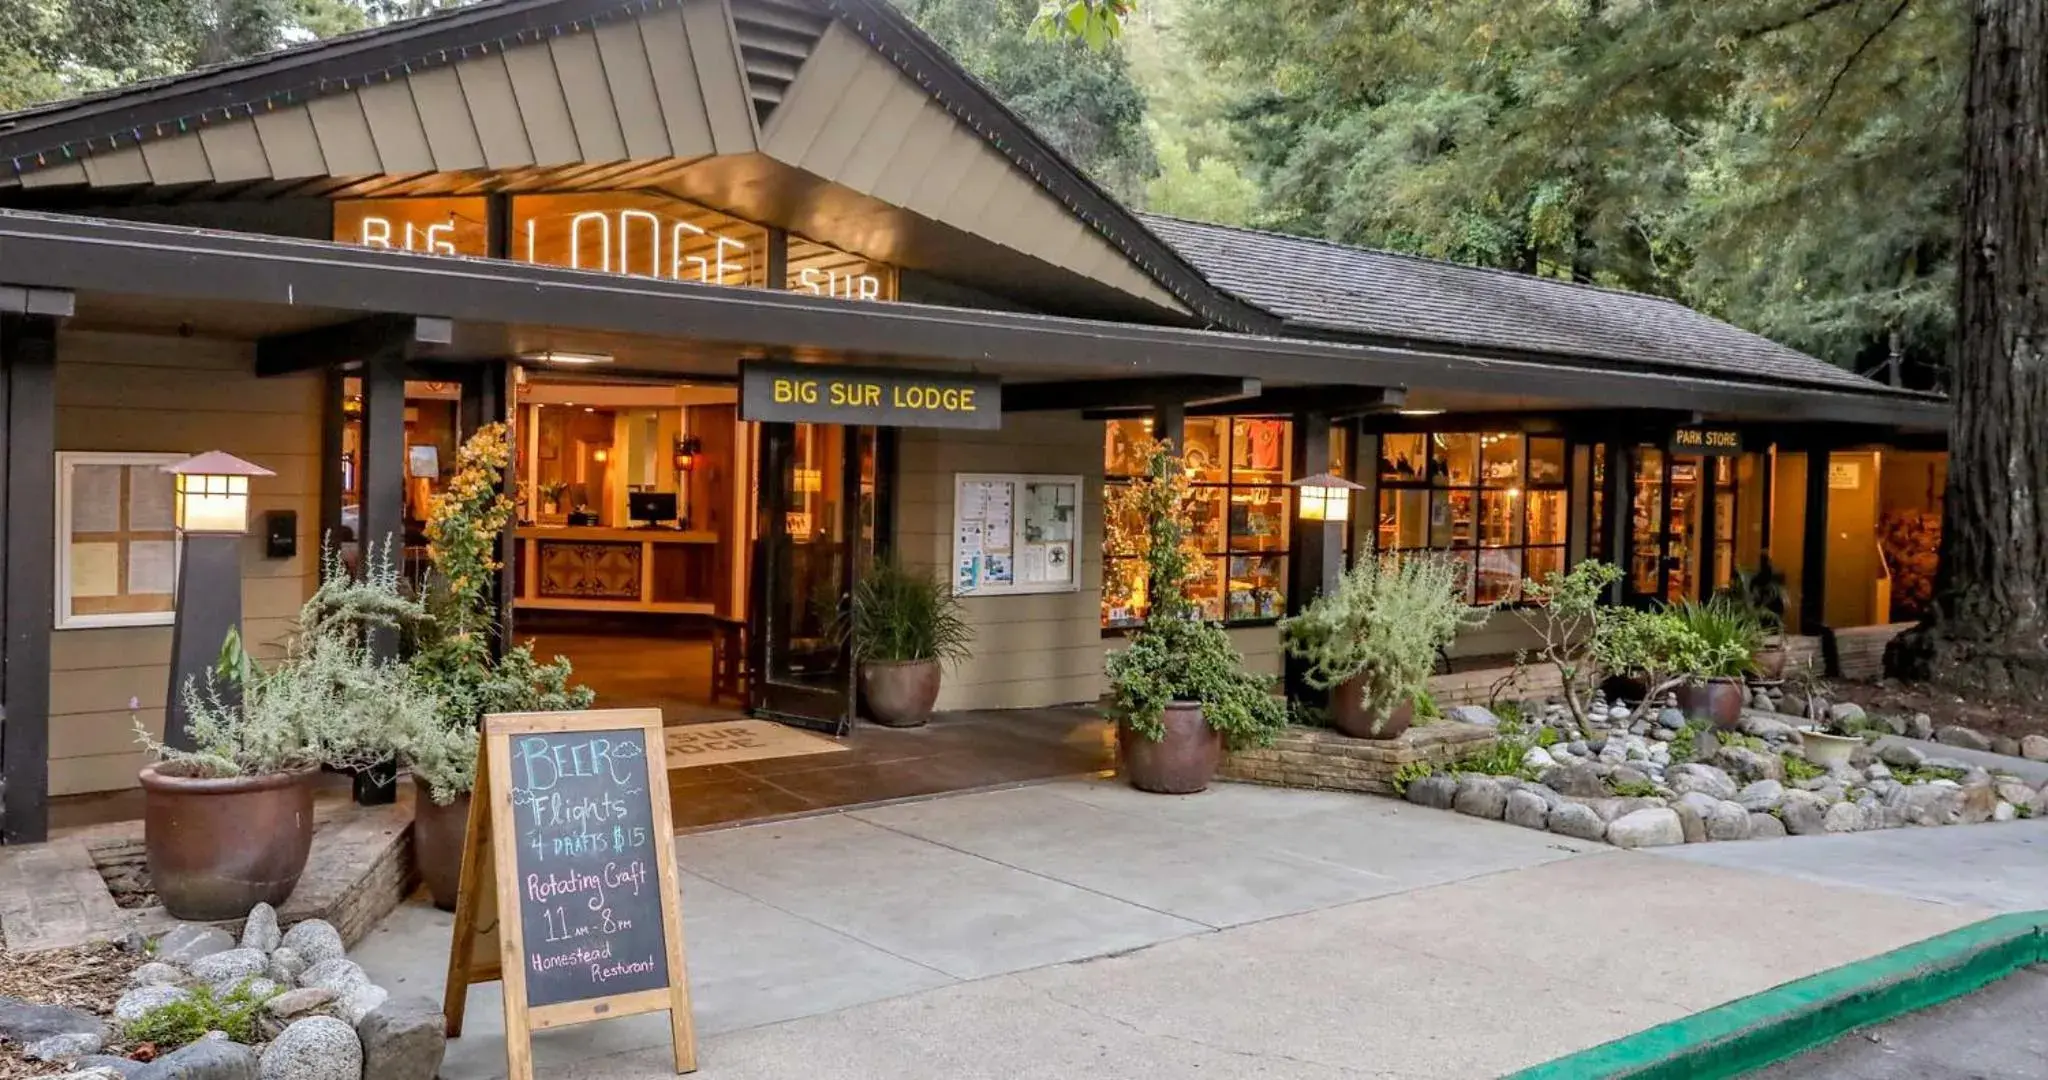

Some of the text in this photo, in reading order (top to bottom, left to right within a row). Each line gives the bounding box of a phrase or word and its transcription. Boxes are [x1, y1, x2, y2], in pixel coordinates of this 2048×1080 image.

[774, 379, 976, 411] BIG SUR LODGE
[1676, 429, 1738, 446] PARK STORE
[665, 738, 767, 756] DGE
[667, 727, 758, 744] SUR
[519, 737, 632, 790] BEER
[530, 791, 628, 834] Flights
[552, 832, 609, 857] DRAFTS
[527, 861, 647, 911] Rotating Craft
[531, 941, 613, 973] Homestead
[591, 955, 655, 984] Resturant
